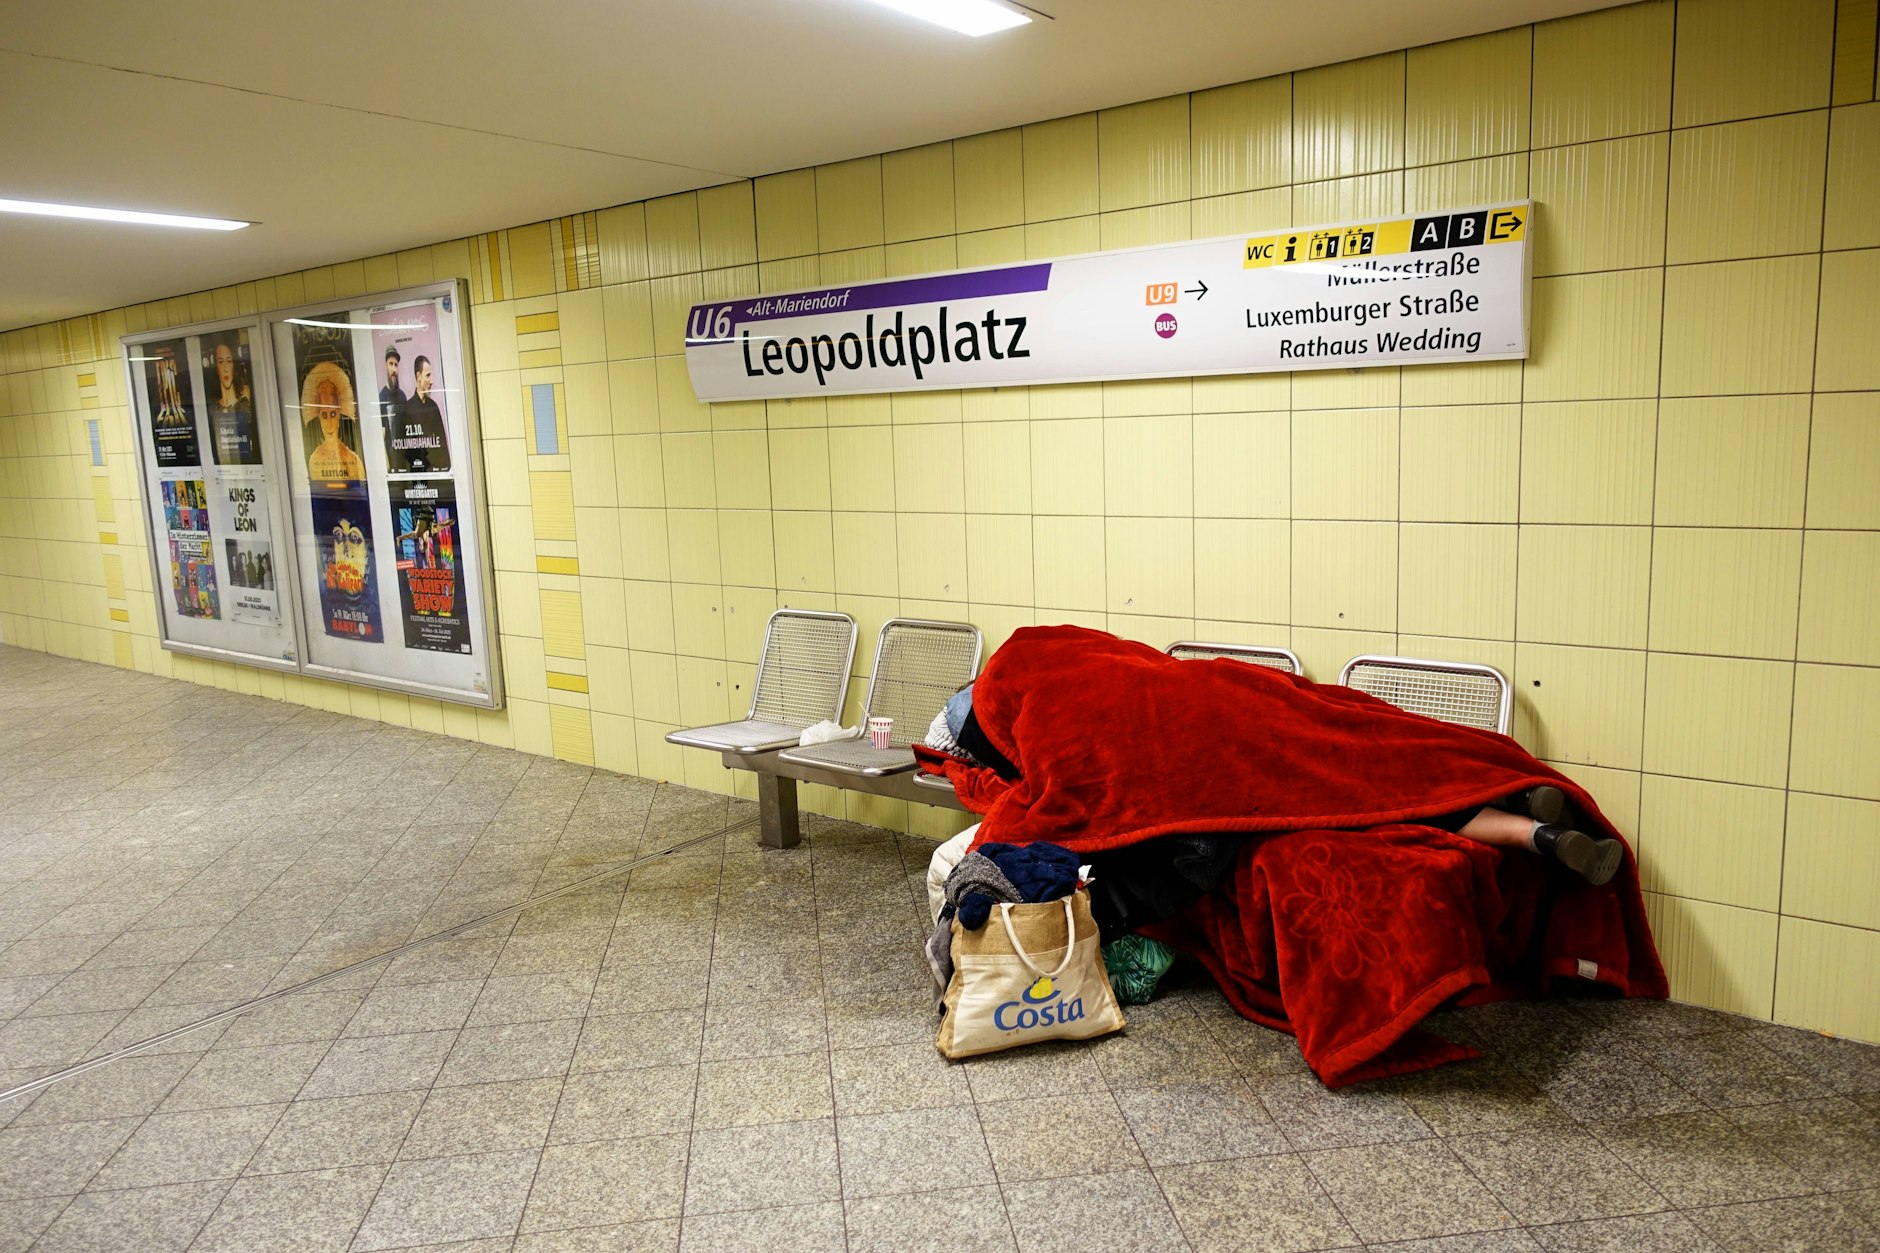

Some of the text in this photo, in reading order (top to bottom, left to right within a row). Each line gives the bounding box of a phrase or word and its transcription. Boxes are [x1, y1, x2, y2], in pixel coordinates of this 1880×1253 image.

[1420, 217, 1476, 244] A B
[1329, 240, 1337, 254] 1
[1361, 236, 1371, 250] 2
[1247, 244, 1274, 261] WC
[1149, 284, 1175, 304] U9
[752, 290, 851, 318] Alt-Mariendorf
[1246, 289, 1479, 329] Luxemburger Straße
[691, 305, 733, 340] U6
[1155, 319, 1177, 333] BUS
[743, 306, 1031, 386] Leopoldplatz
[1279, 326, 1482, 359] Rathaus Wedding
[405, 424, 424, 436] 21.10.
[393, 436, 441, 450] COLUMBIAHALLE
[321, 469, 349, 478] BABYLON
[229, 488, 256, 503] KINGS
[238, 503, 249, 518] OF
[234, 518, 257, 532] LEON
[407, 568, 453, 580] WOODSTOCK
[409, 579, 453, 594] VARIETY
[413, 593, 453, 612] SHOW
[331, 619, 373, 636] BABYLON
[993, 997, 1085, 1031] Costa
